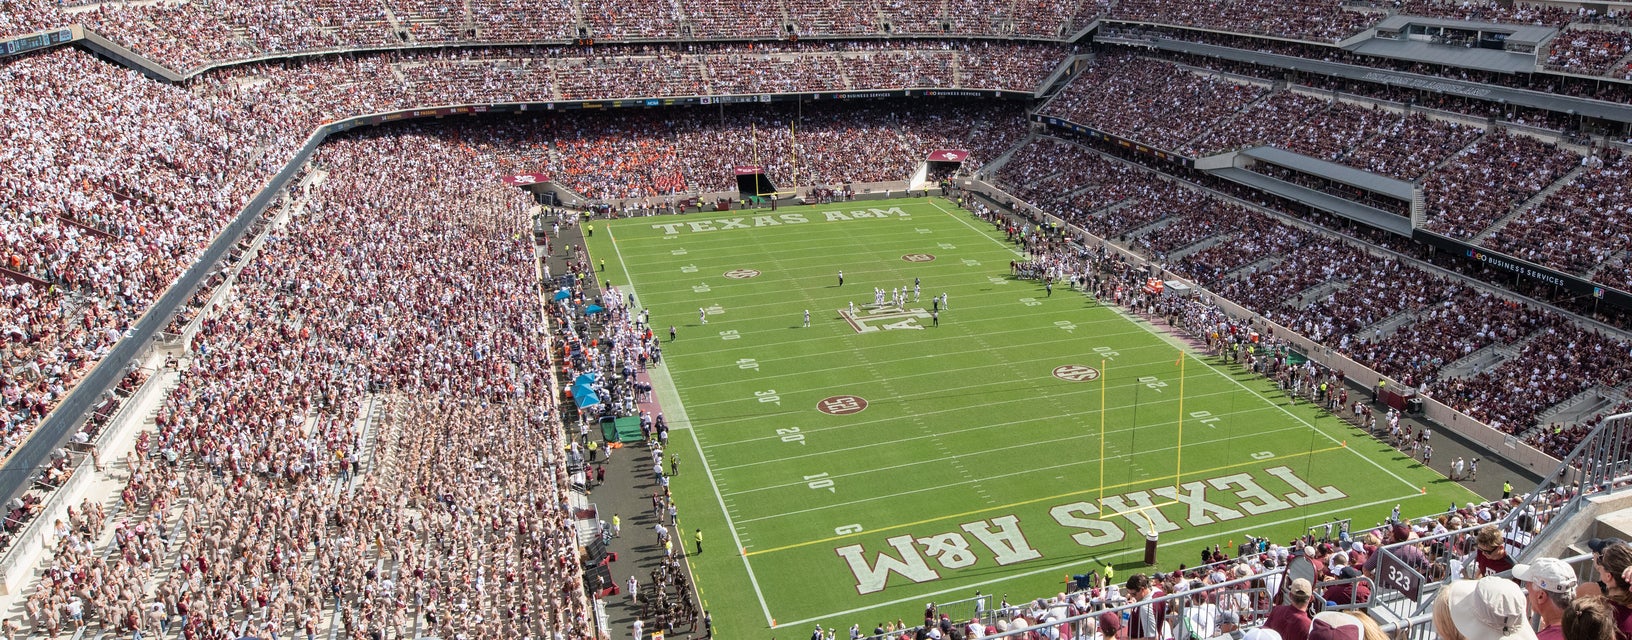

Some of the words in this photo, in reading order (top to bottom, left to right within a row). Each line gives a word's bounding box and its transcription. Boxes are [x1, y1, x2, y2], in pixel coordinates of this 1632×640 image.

[651, 213, 809, 235] TEXAS
[822, 206, 911, 222] A&M
[1488, 257, 1525, 274] BUSINESS
[1527, 269, 1565, 287] SERVICES
[754, 389, 781, 403] 30
[776, 426, 805, 443] 20
[803, 472, 835, 489] 10
[1048, 465, 1348, 547] TEXAS
[834, 523, 863, 536] G
[834, 513, 1044, 596] A&M
[1388, 565, 1411, 591] 323
